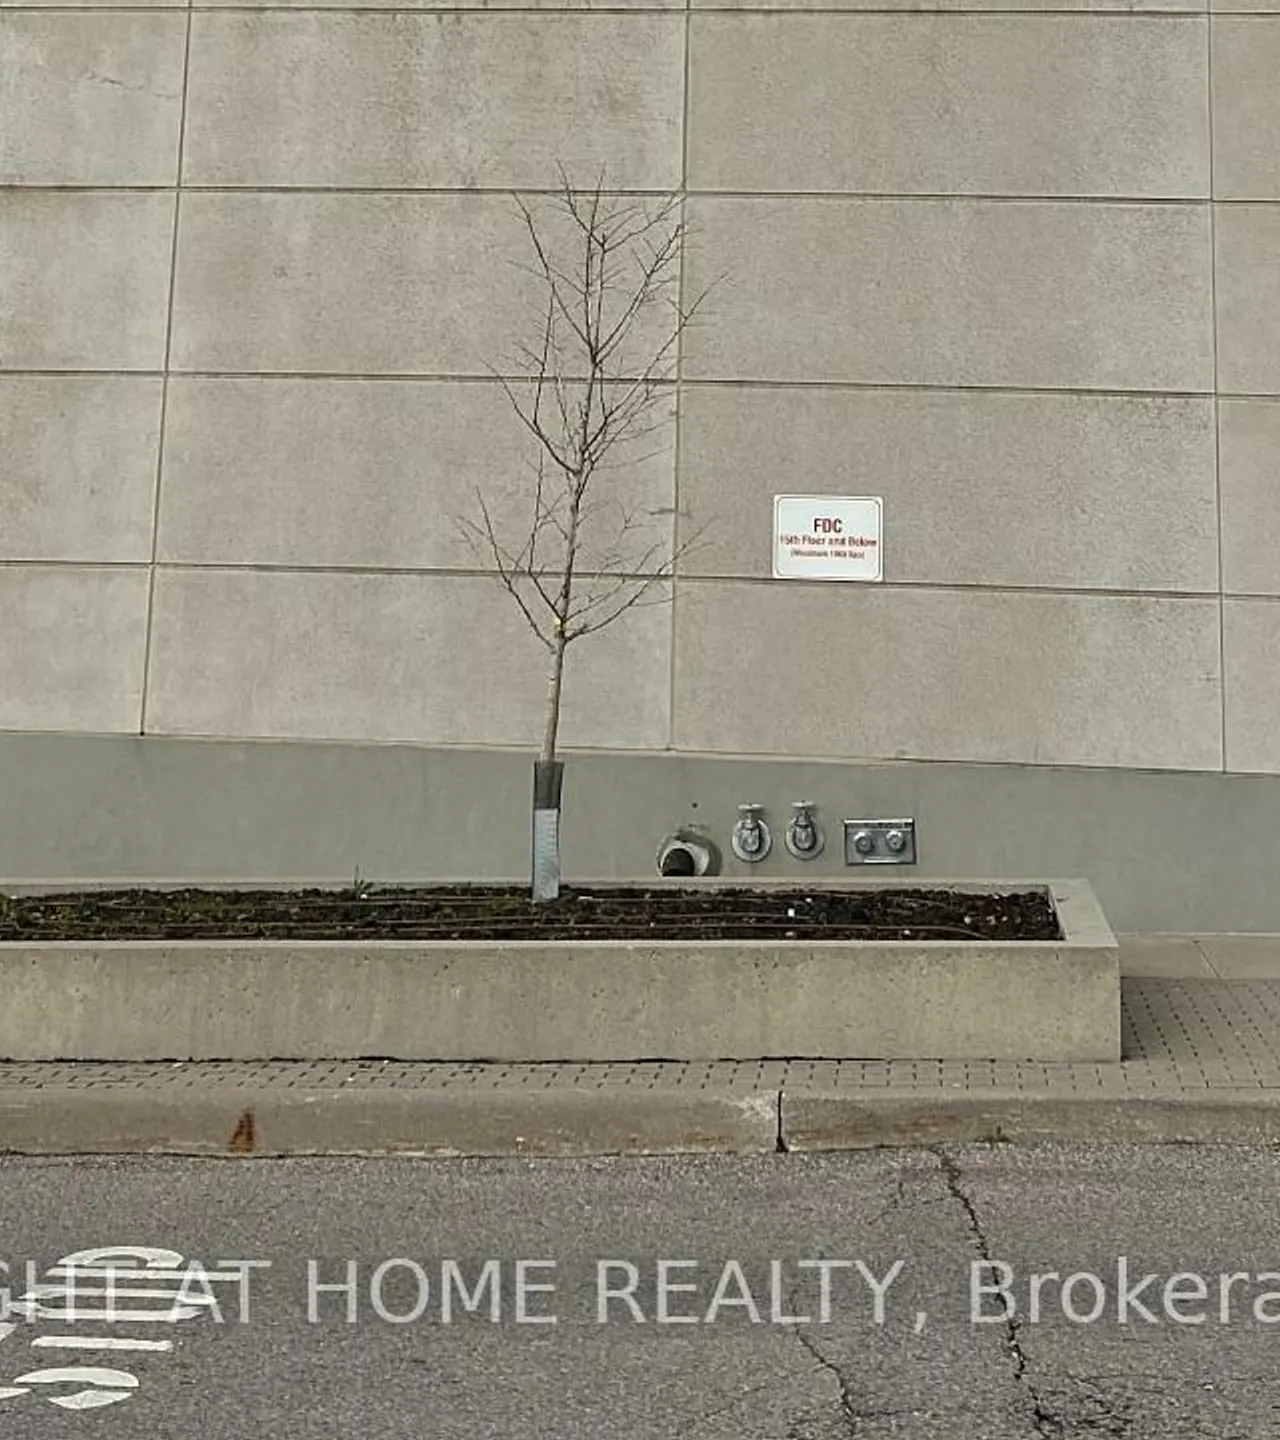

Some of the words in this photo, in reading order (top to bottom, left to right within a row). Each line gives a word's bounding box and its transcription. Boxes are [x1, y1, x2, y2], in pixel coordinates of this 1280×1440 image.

[813, 517, 843, 534] FDC
[802, 535, 826, 546] Floor
[828, 536, 847, 546] and
